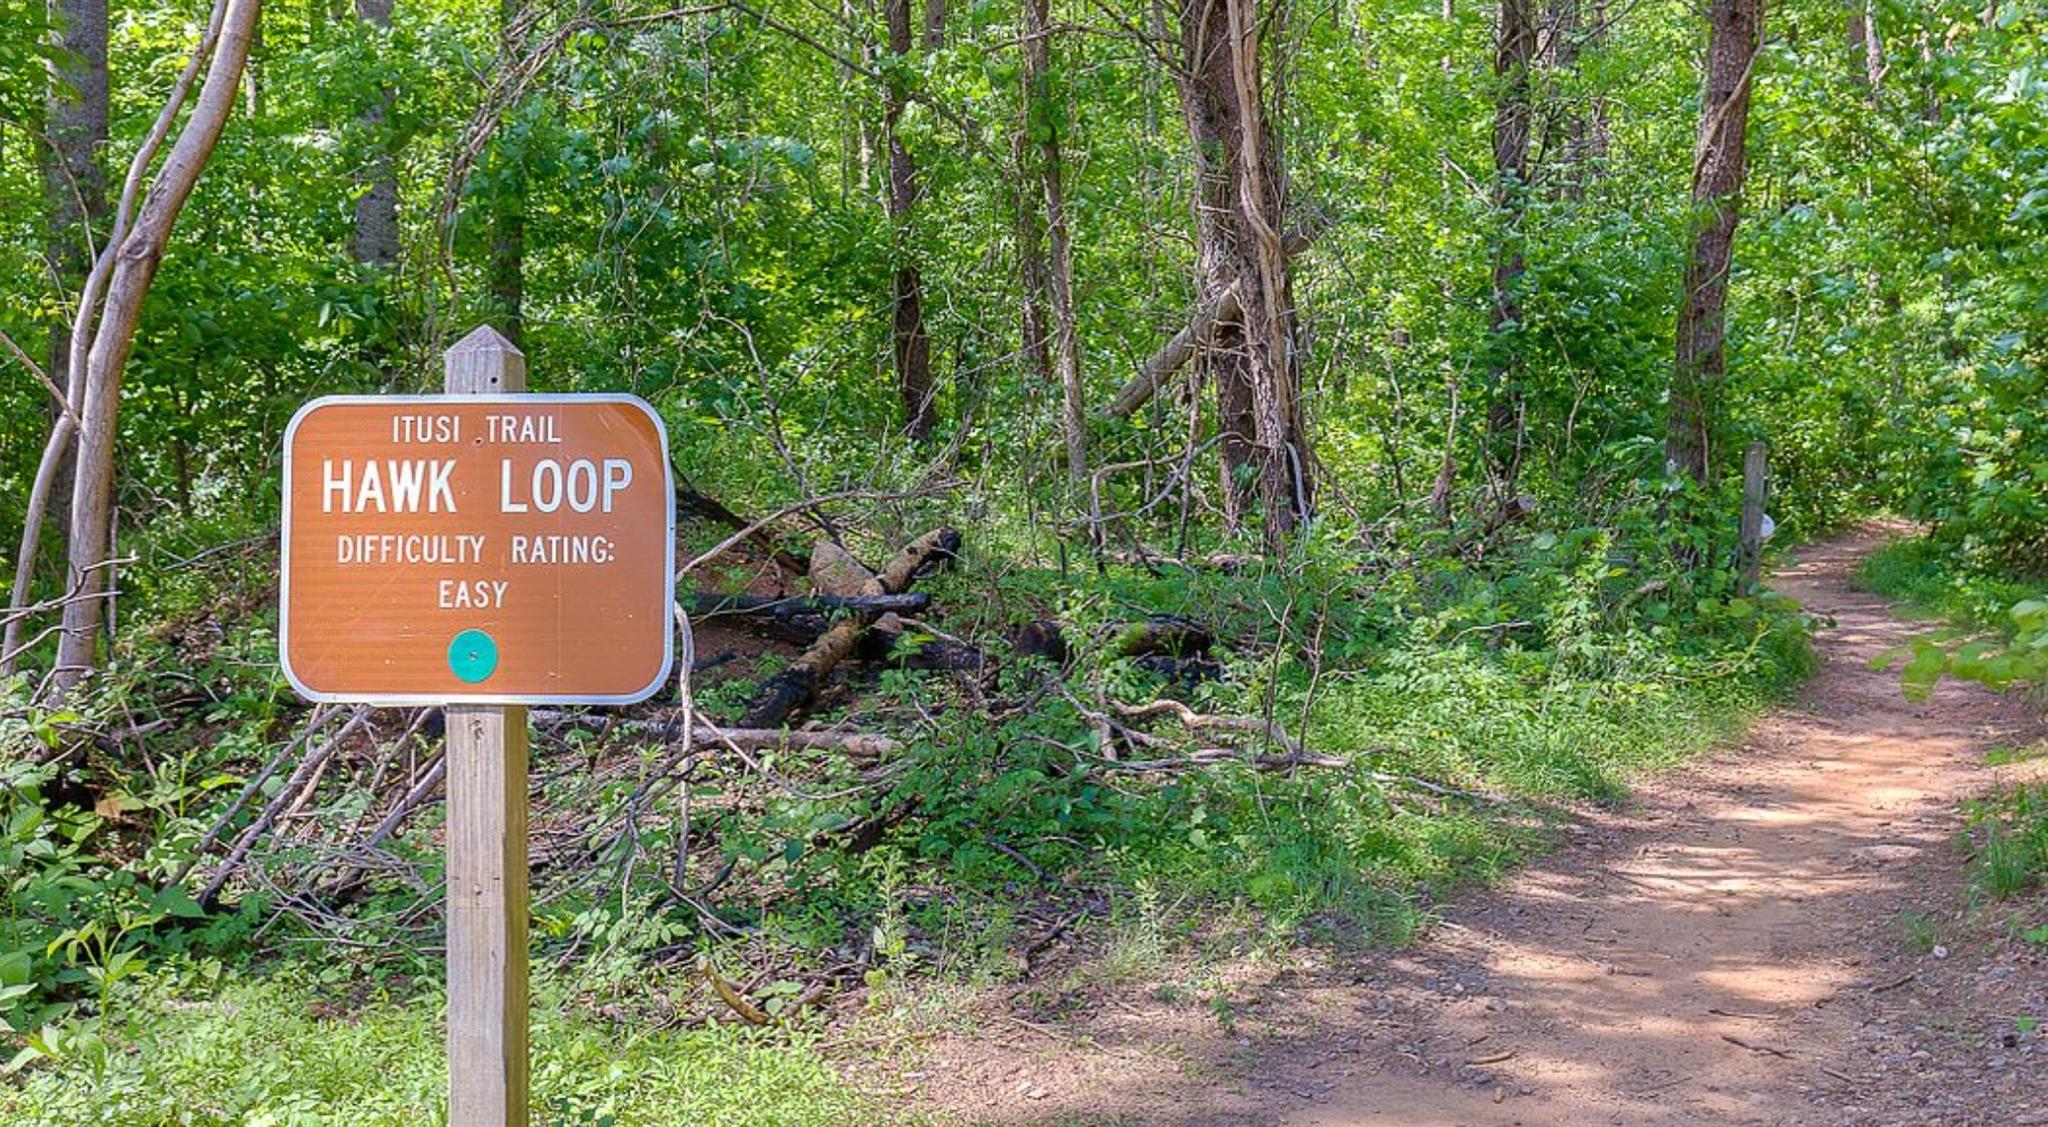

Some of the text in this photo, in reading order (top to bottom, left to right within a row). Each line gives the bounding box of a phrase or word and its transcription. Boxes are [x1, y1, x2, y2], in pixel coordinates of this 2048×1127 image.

[392, 415, 562, 443] ITUSI TRAIL
[322, 458, 633, 513] HAWK LOOP
[337, 535, 615, 564] DIFFICULTY RATING:
[438, 580, 508, 608] EASY
